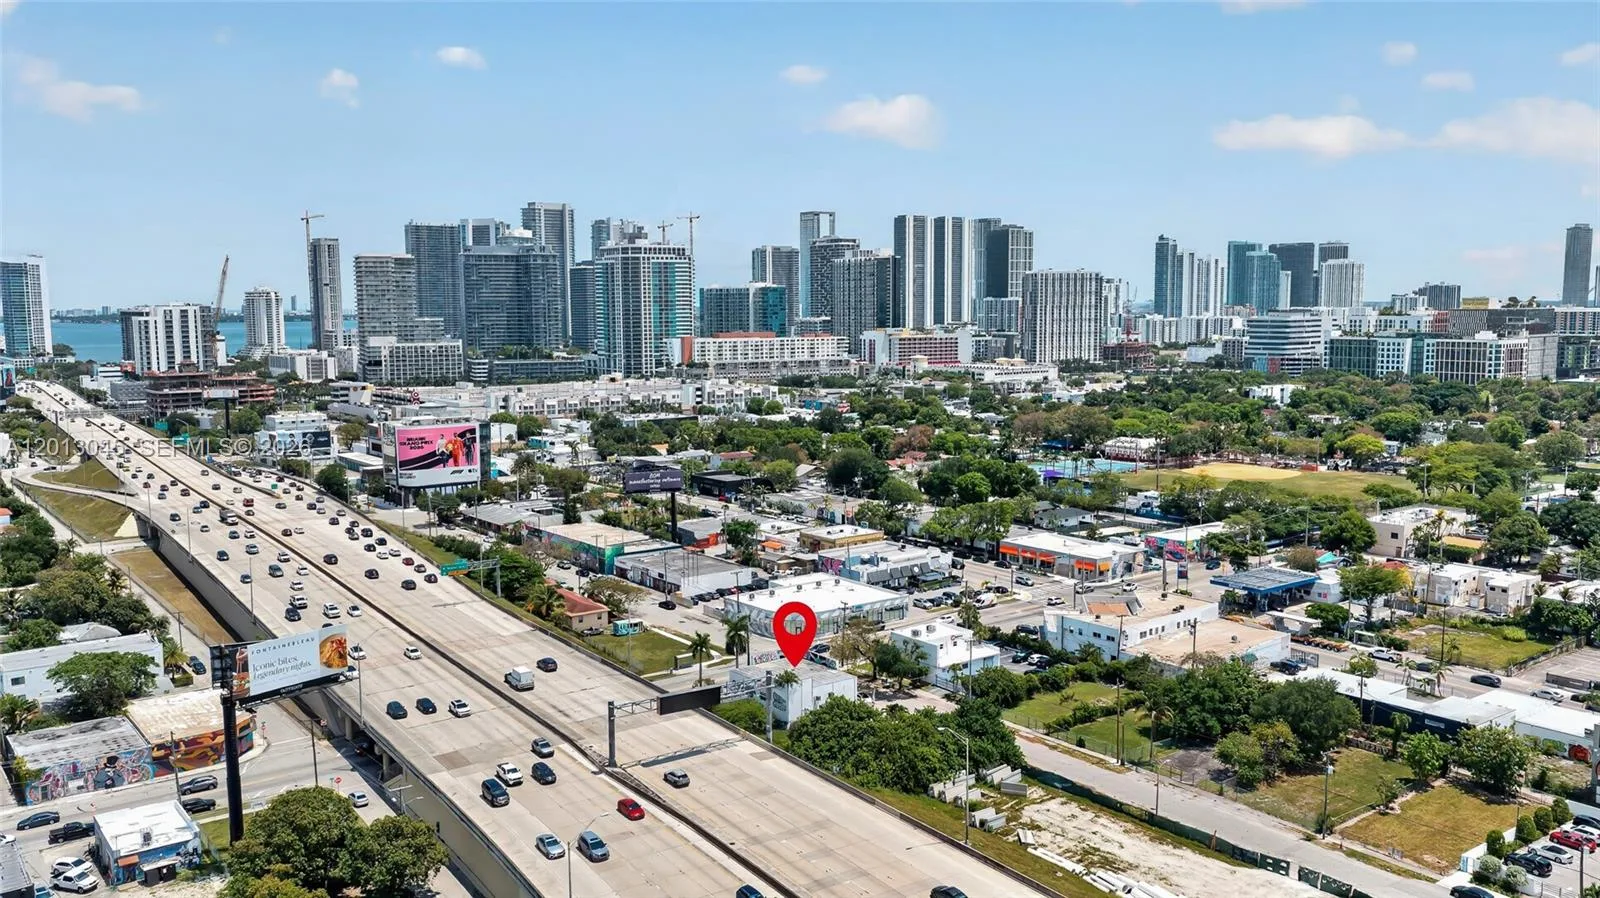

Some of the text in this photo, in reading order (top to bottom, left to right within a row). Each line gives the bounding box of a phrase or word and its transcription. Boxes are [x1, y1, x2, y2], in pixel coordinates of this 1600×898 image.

[251, 637, 315, 655] FONTAINEBLEAU
[252, 659, 276, 672] Iconic
[253, 666, 290, 681] Legendary
